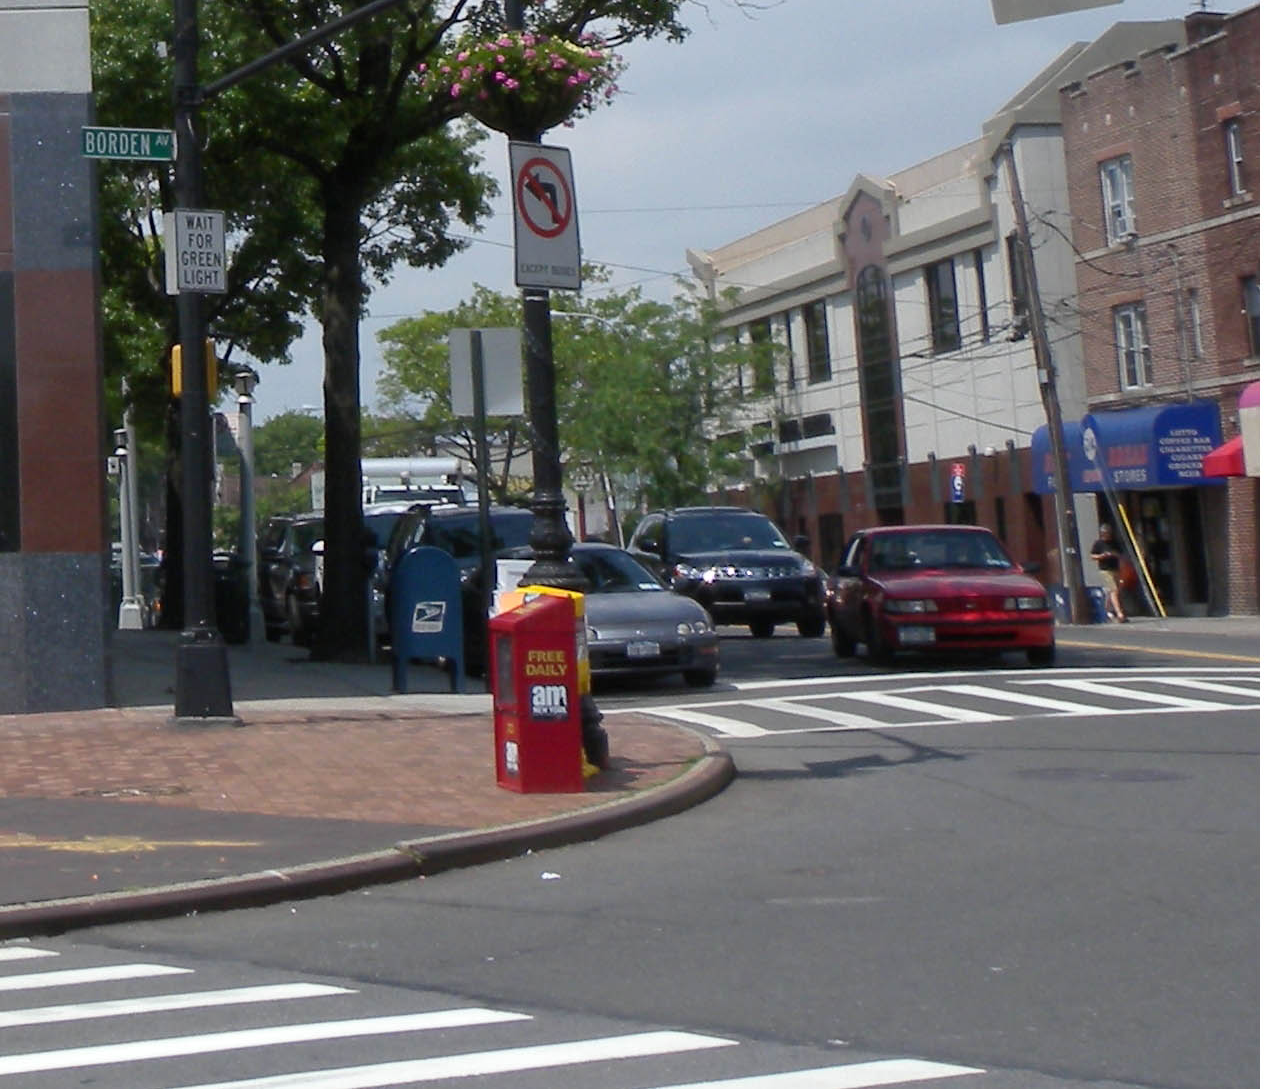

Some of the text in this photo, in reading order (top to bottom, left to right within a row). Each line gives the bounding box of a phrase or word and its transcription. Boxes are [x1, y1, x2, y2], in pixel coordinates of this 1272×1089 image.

[85, 131, 171, 156] BORDEN AV
[185, 215, 215, 230] WAIT
[188, 234, 213, 248] FOR
[181, 251, 222, 267] GREEN
[184, 270, 219, 285] LIGHT
[1113, 469, 1147, 483] STORES
[528, 650, 565, 662] FREE
[526, 664, 568, 676] DAILY
